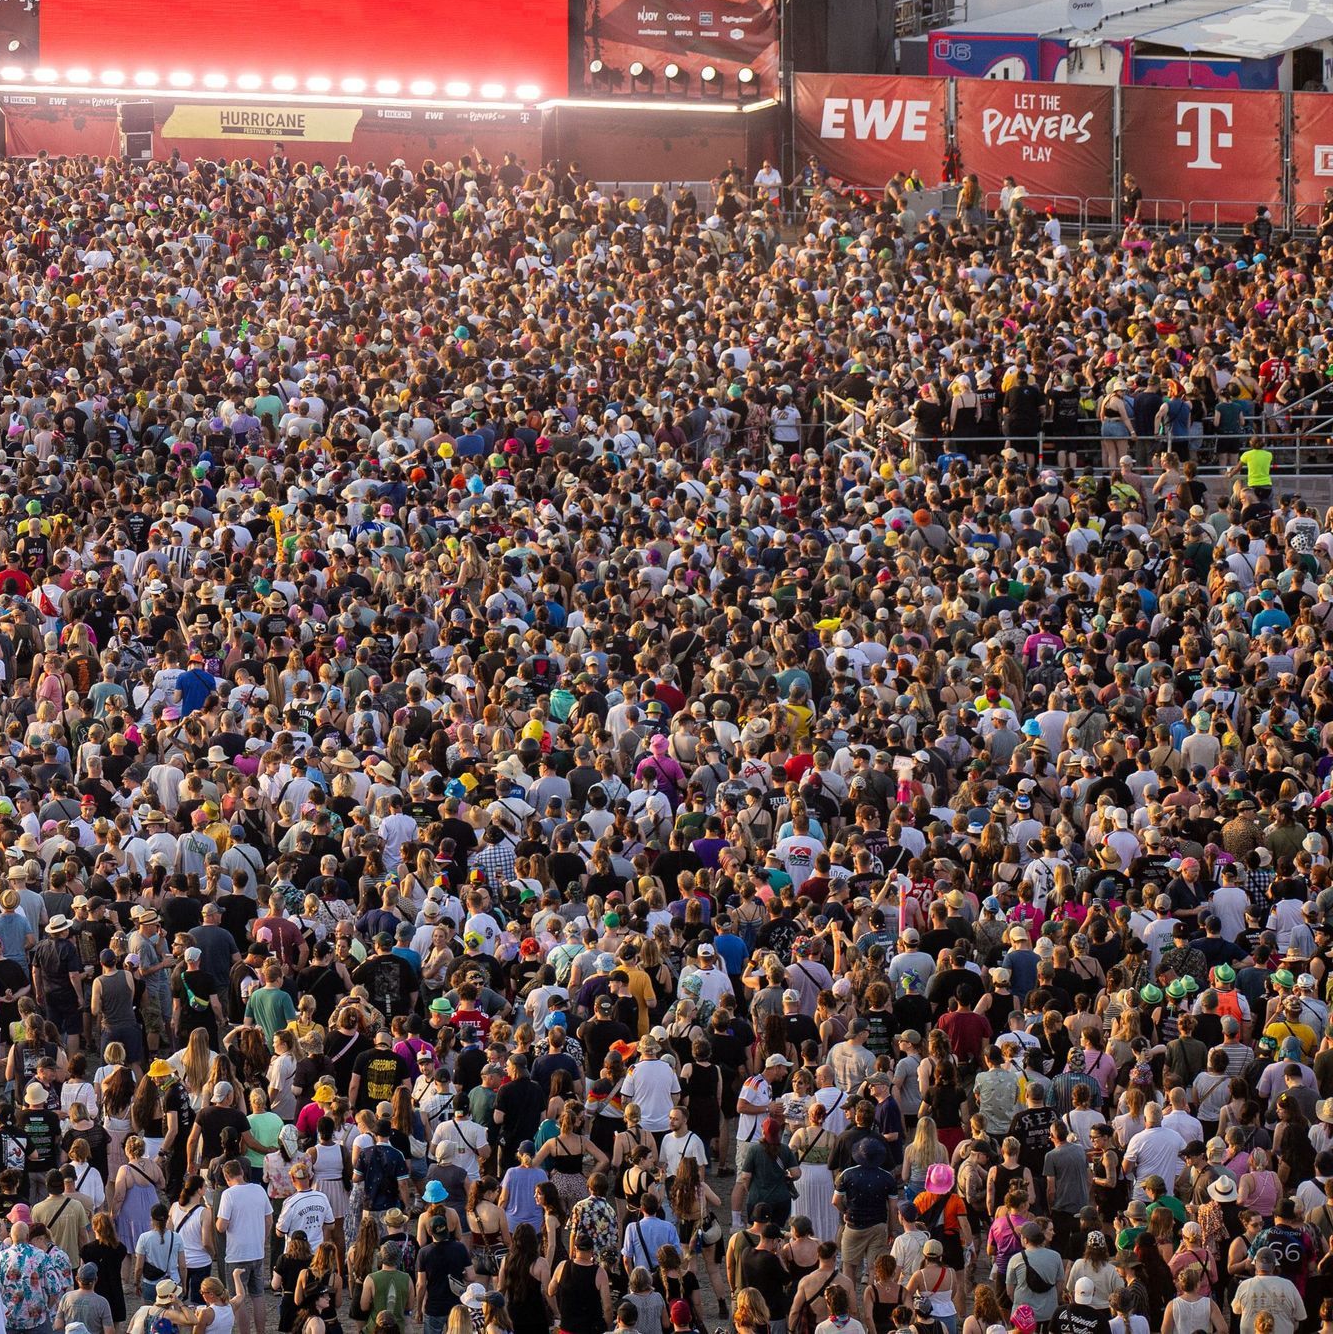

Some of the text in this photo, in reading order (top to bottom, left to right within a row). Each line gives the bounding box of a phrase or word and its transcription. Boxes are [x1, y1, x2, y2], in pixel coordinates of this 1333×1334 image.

[49, 97, 67, 105] EWE
[1014, 93, 1061, 111] LET THE
[220, 111, 305, 128] HURRICANE
[425, 112, 444, 120] EWE
[820, 97, 931, 142] EWE
[982, 108, 1094, 148] PLAYERS
[1177, 101, 1233, 170] T
[1022, 146, 1053, 162] PLAY
[298, 1205, 325, 1217] WELTMEISTER
[305, 1215, 319, 1224] 2014
